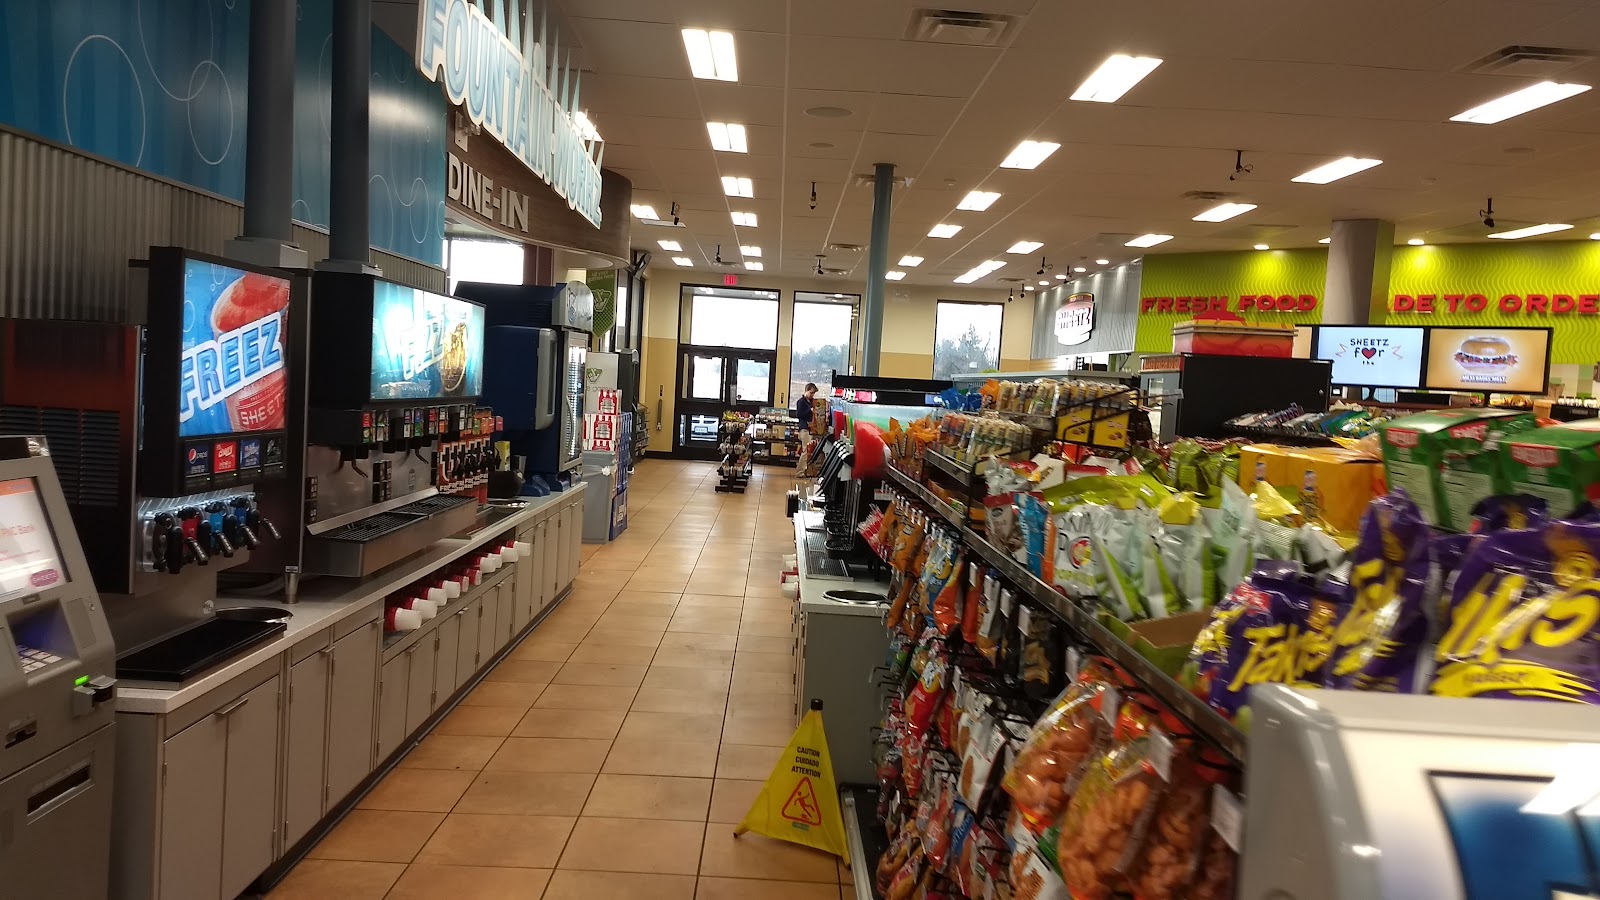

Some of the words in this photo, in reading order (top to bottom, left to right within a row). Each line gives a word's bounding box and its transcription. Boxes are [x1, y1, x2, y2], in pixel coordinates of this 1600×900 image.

[447, 151, 530, 233] DINE-IN
[1141, 296, 1229, 313] FRESH
[1238, 294, 1317, 311] FOOD
[1392, 293, 1436, 313] DE
[1443, 294, 1488, 313] TO
[1350, 338, 1389, 346] SHEETZ
[181, 317, 282, 416] FREEZ
[797, 746, 820, 757] CAUTION
[795, 756, 820, 768] CUIDADO
[791, 765, 821, 778] ATTENTION
